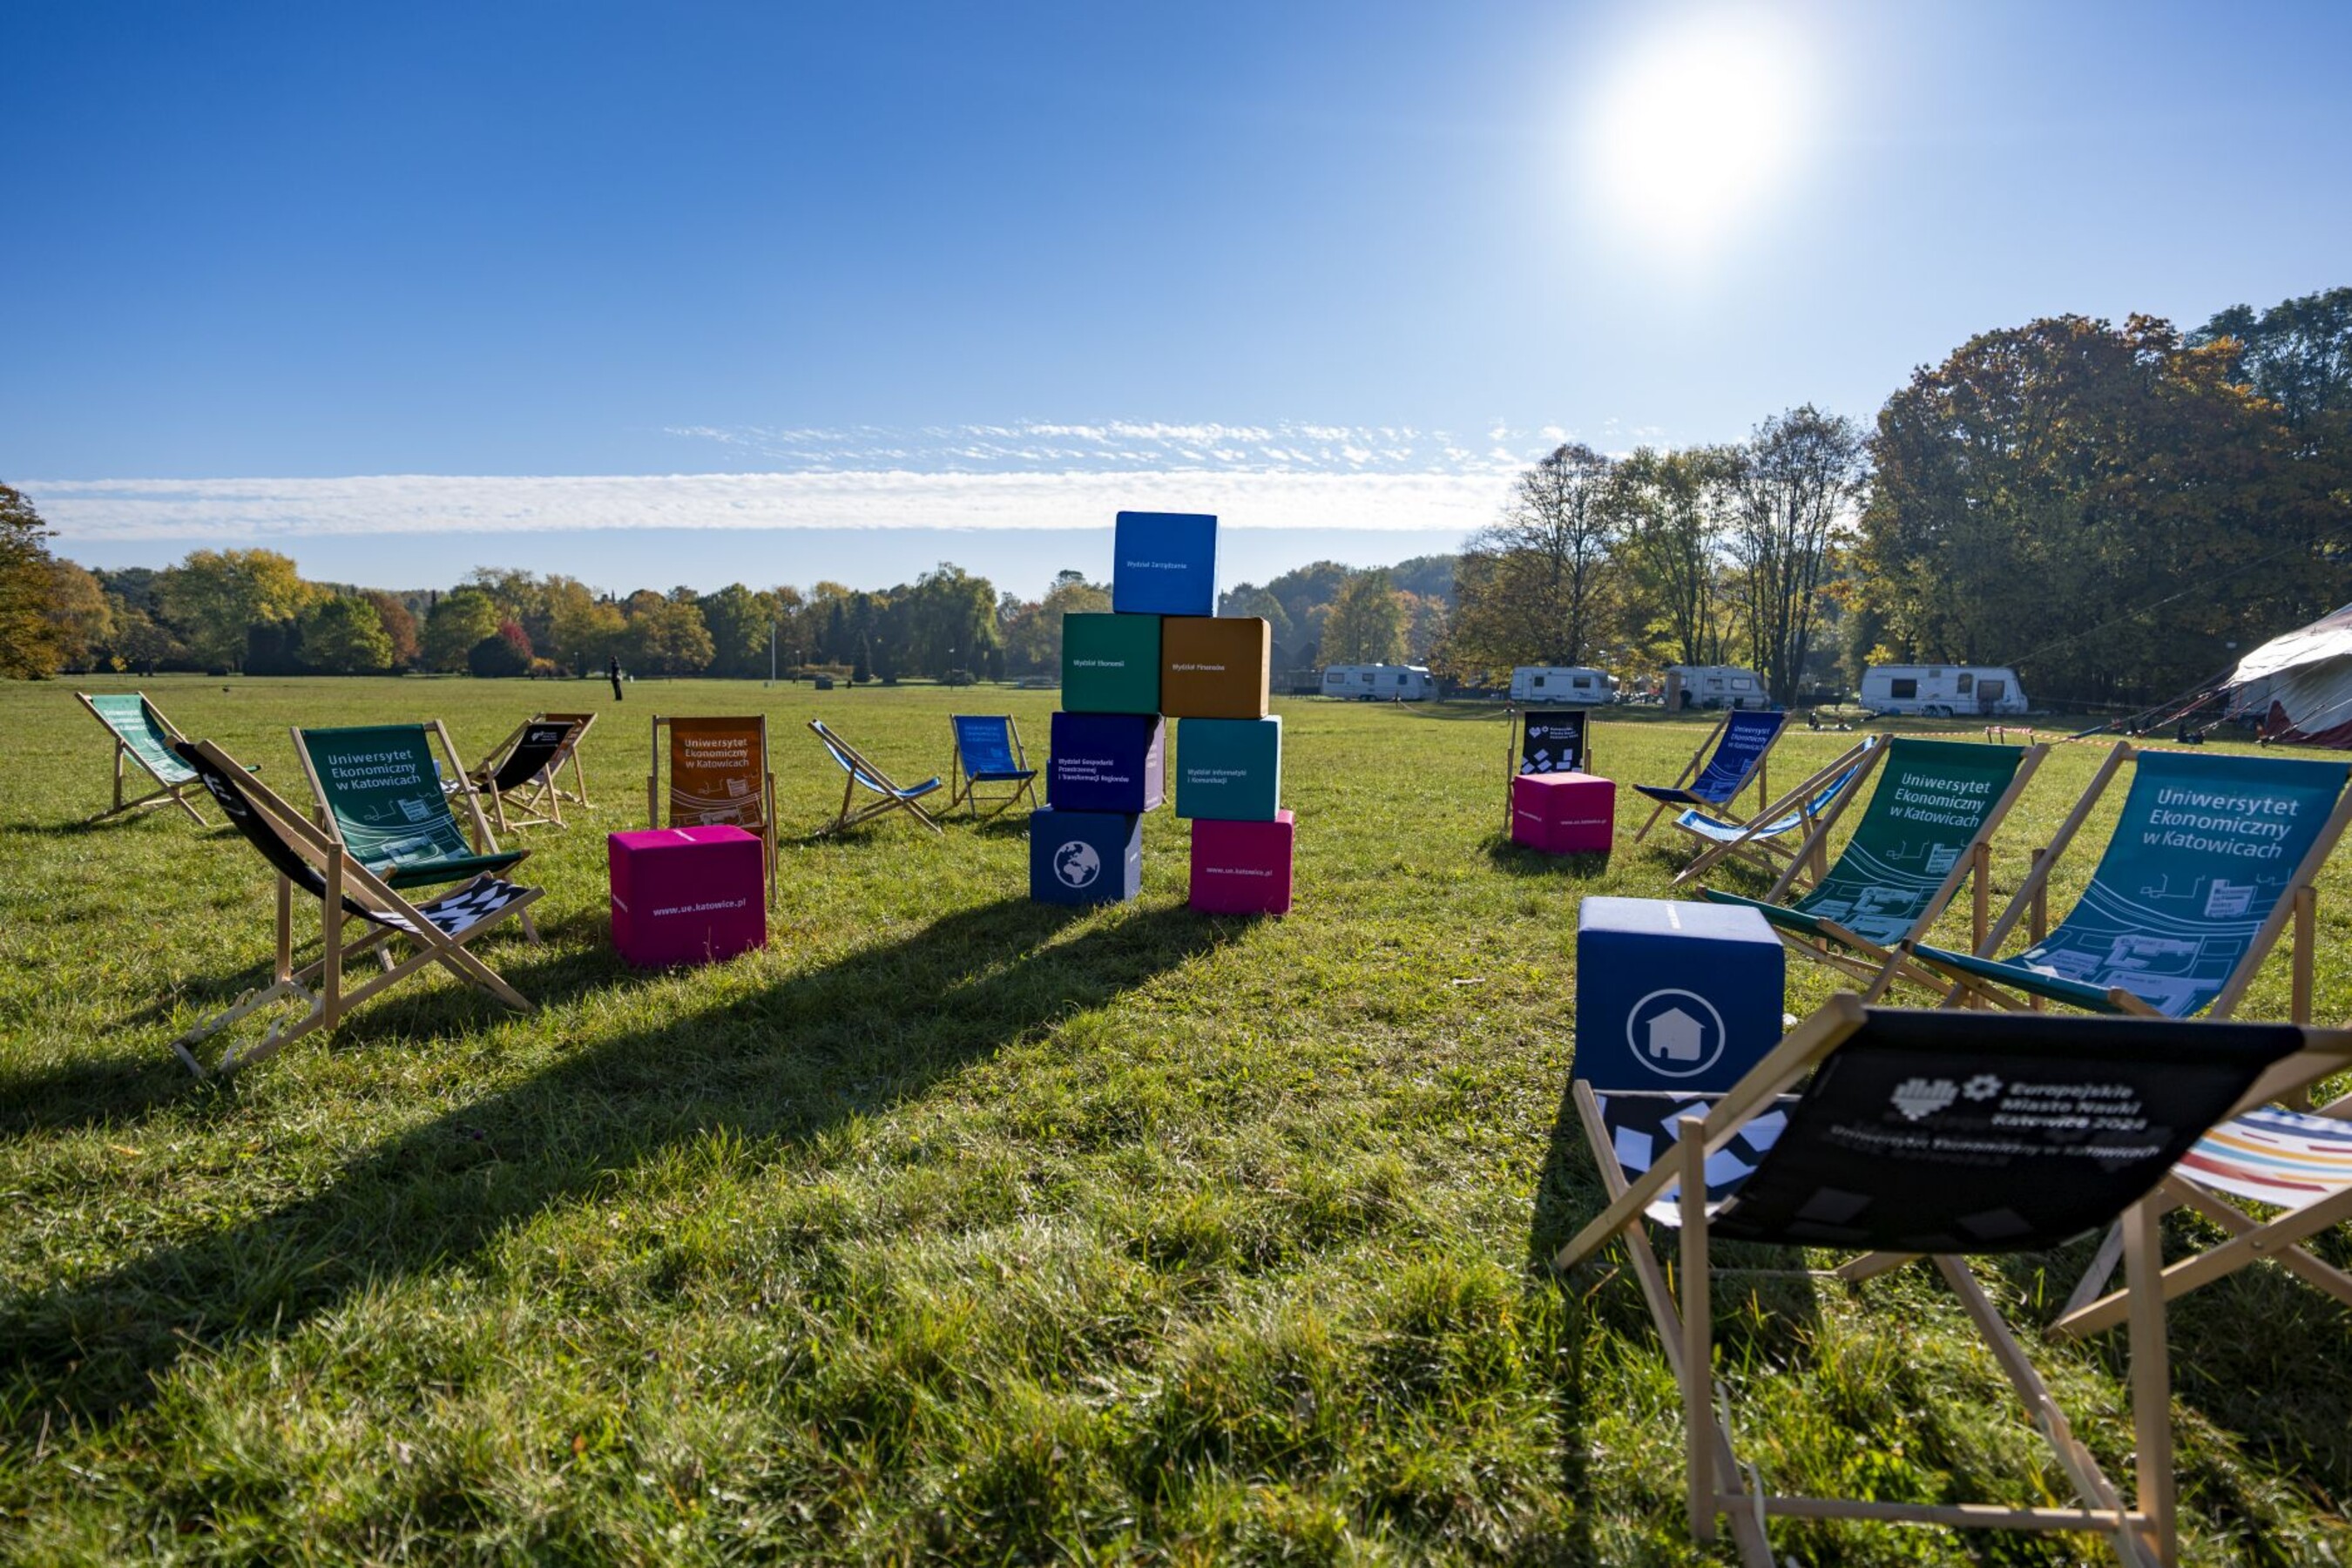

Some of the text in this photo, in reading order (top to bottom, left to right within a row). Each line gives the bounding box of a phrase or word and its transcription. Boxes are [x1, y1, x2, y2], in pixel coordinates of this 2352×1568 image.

[1126, 560, 1150, 569] Wydział
[685, 738, 747, 748] Uniwersytet
[328, 749, 414, 766] Uniwersytet
[686, 748, 748, 758] Ekonomiczny
[331, 763, 416, 779] Ekonomiczny
[697, 758, 749, 767] Katowicach
[336, 774, 421, 790] w Katowicach
[1062, 774, 1100, 782] Transformacji
[1101, 774, 1130, 783] Regionów
[1902, 772, 1991, 794] Uniwersytet
[1895, 788, 1985, 814] Ekonomiczny
[2158, 788, 2300, 816] Uniwersytet
[1889, 806, 1979, 828] w Katowicach
[2150, 809, 2292, 841] Ekonomiczny
[2143, 830, 2282, 859] w Katowicach
[1206, 868, 1273, 876] www.ue.katowice.pl
[653, 897, 747, 916] www.ue.katowice.pl
[2009, 1082, 2134, 1100] Europejskie
[2000, 1098, 2143, 1116] Miasto Nauki
[1990, 1113, 2148, 1132] Katowice 2024
[1932, 1138, 2041, 1157] Ekonomiczny
[2044, 1146, 2058, 1156] w
[2062, 1145, 2161, 1159] Katowicach
